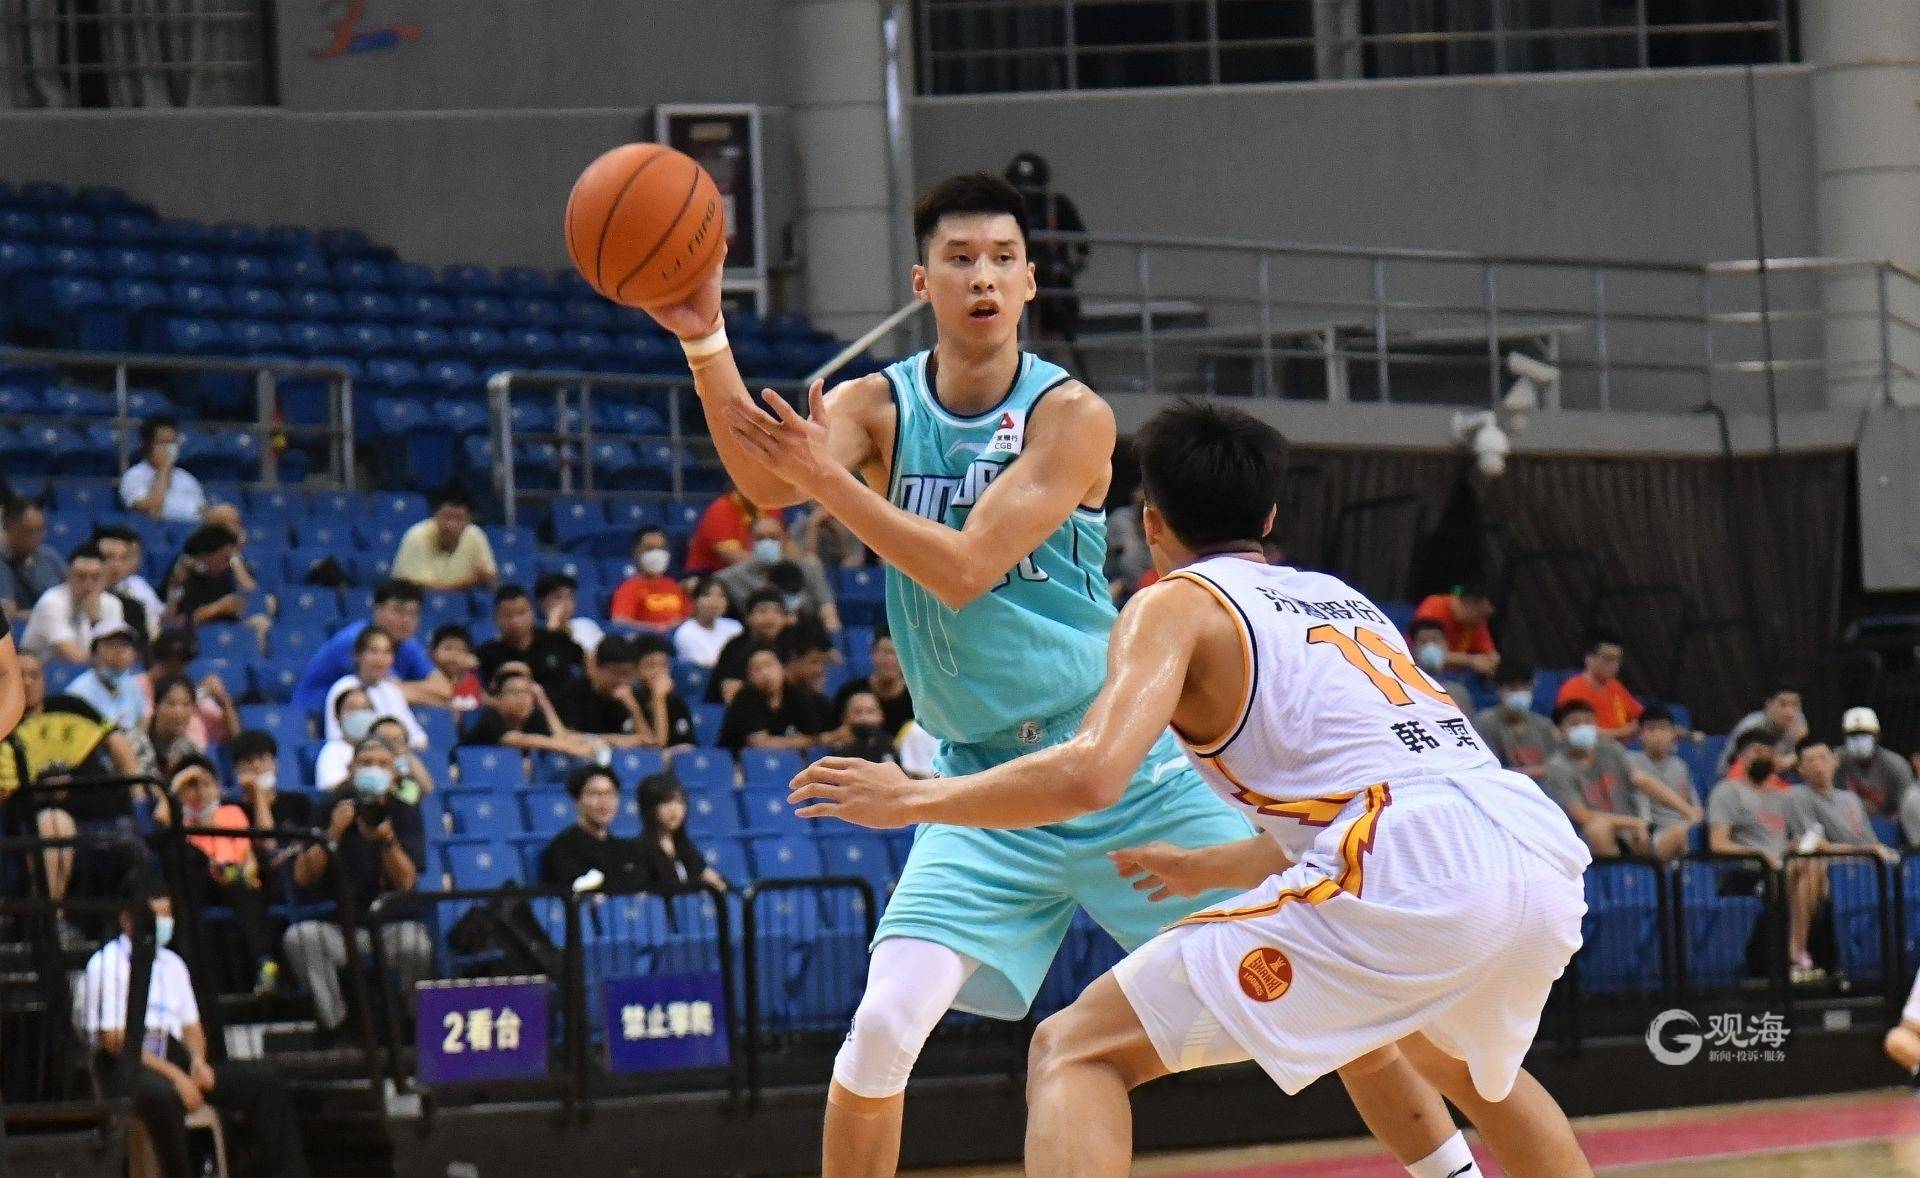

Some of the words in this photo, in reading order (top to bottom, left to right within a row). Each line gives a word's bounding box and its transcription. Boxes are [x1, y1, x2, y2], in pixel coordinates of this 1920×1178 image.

[994, 442, 1012, 450] CGB
[1247, 957, 1283, 994] SHANXI
[442, 1007, 521, 1054] 2看台
